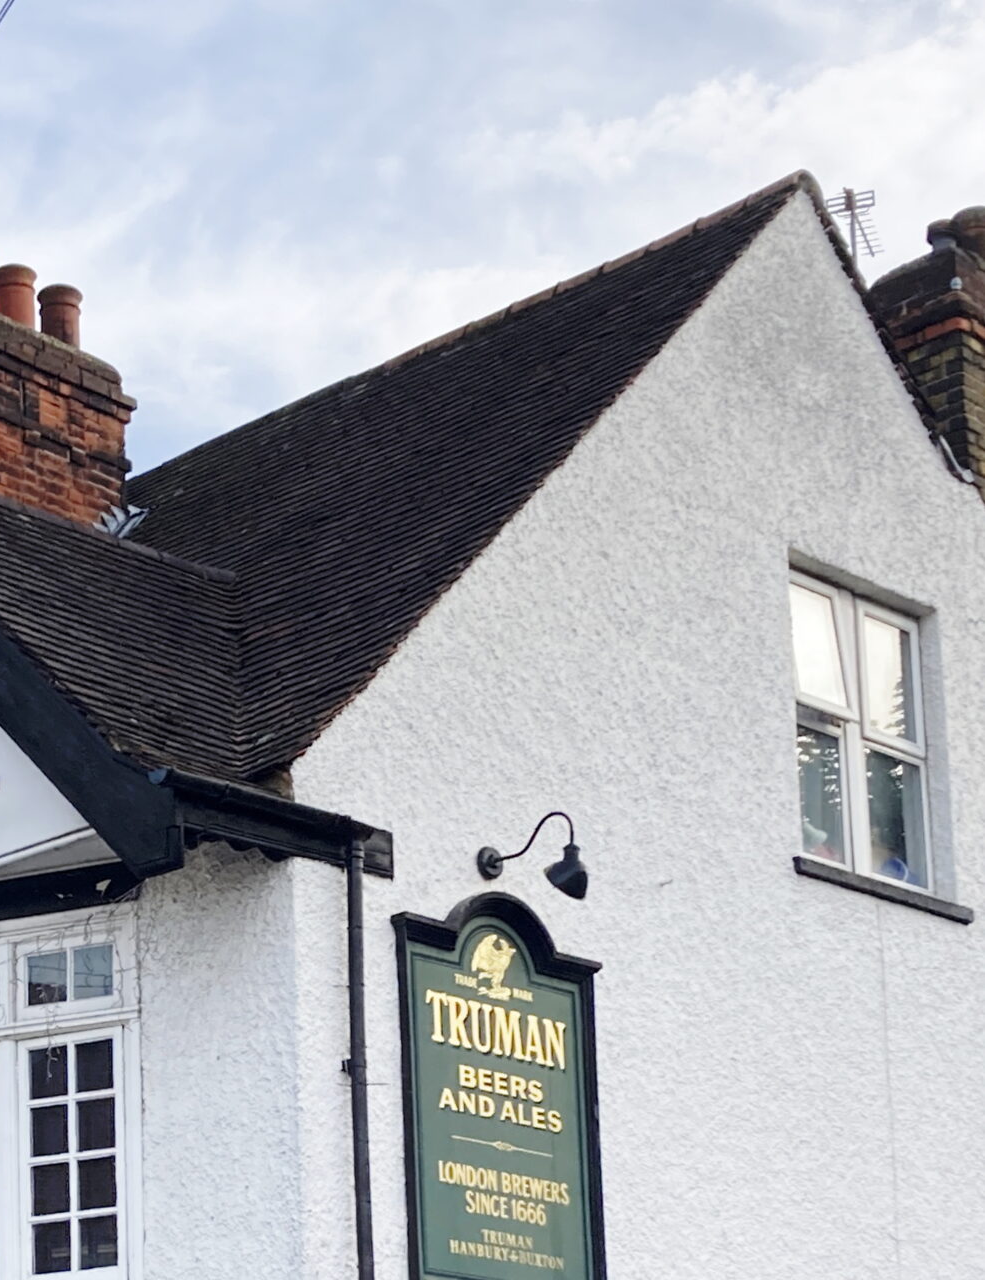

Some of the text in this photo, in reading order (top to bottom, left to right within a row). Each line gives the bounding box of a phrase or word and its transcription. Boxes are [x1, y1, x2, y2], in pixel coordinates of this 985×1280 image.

[425, 988, 567, 1072] TRUMAN
[458, 1063, 544, 1104] BEERS
[439, 1087, 564, 1134] AND ALES
[437, 1159, 571, 1207] LONDON BREWERS
[465, 1189, 547, 1227] SINCE 1666
[480, 1228, 534, 1250] TRUMAN
